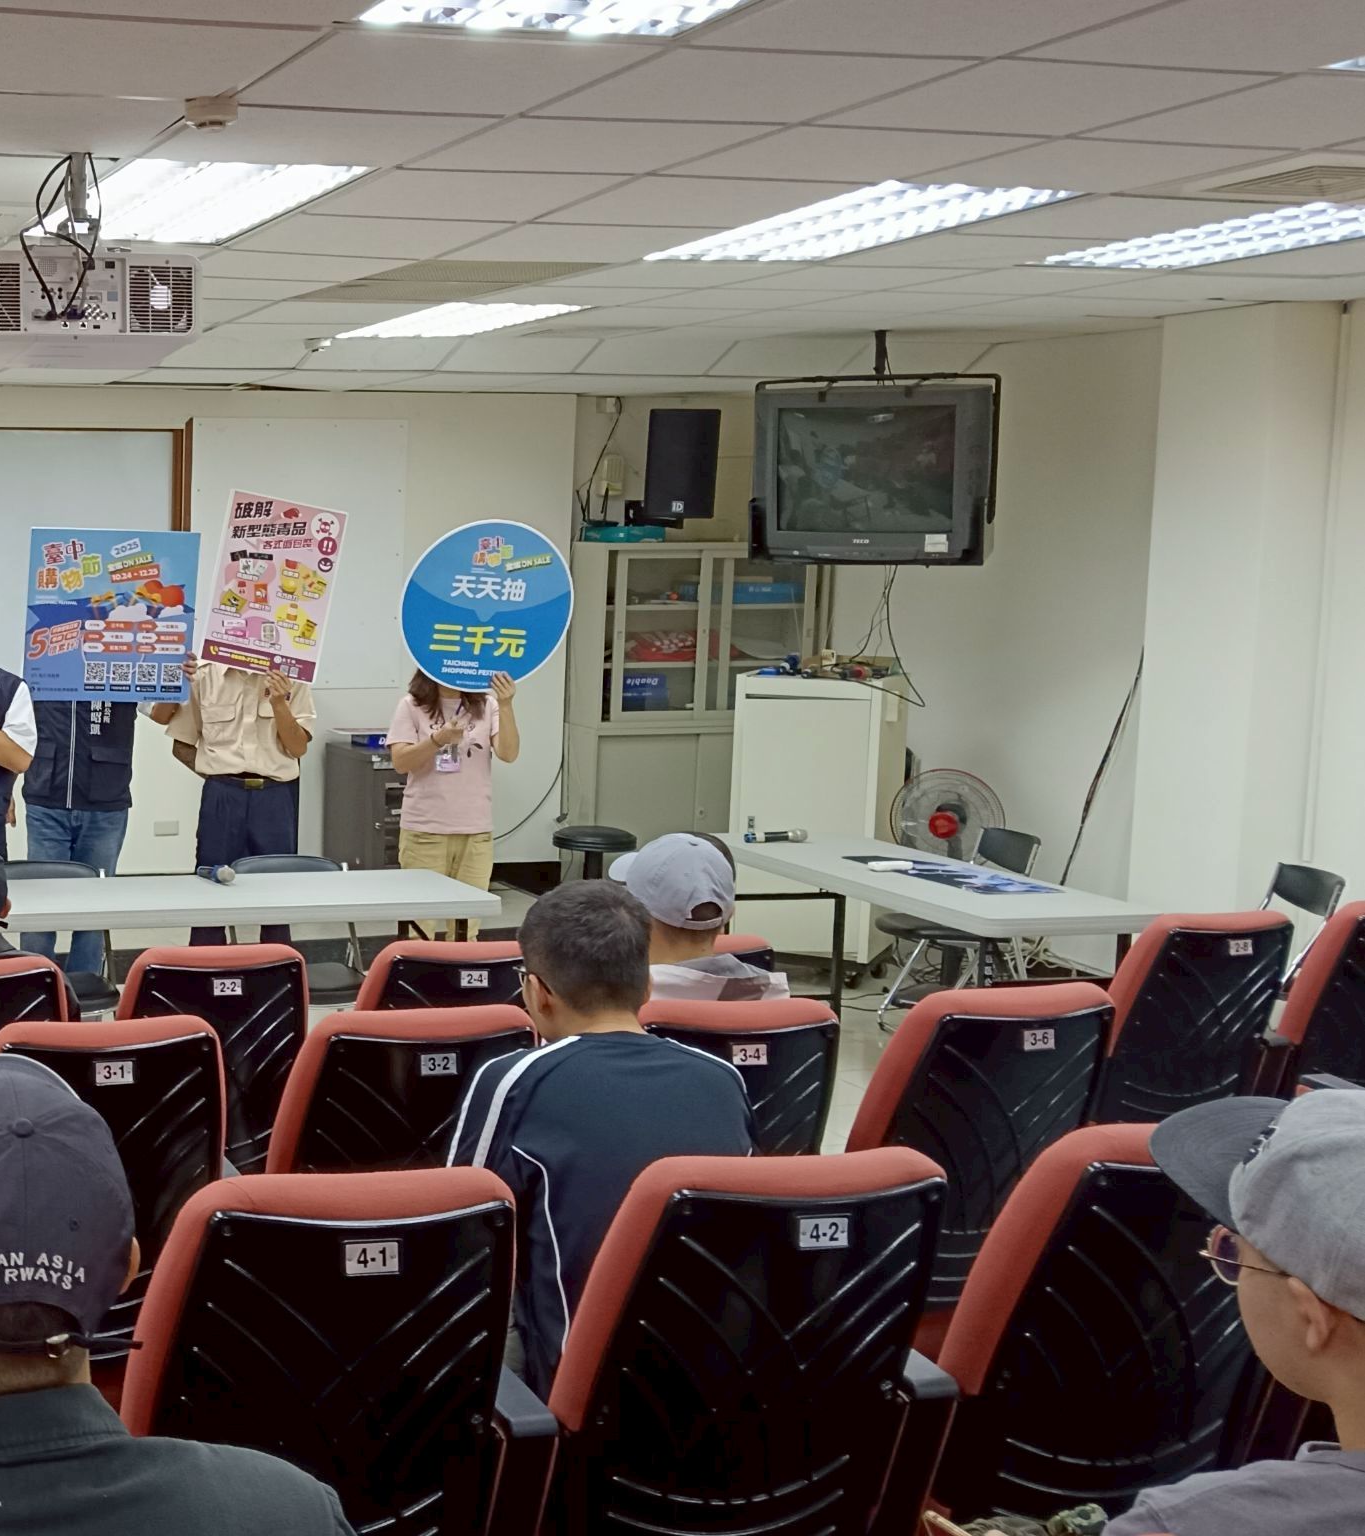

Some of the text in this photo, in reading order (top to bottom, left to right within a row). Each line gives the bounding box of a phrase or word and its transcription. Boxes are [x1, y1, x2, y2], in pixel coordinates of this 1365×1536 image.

[234, 501, 274, 519] 破解
[232, 521, 307, 539] 新型態毒品
[44, 540, 84, 564] 臺中
[114, 541, 139, 555] 2025
[123, 560, 134, 569] ON
[135, 554, 152, 564] SALE
[533, 556, 551, 565] SALE
[450, 574, 526, 602] 天天抽
[29, 628, 50, 658] 5
[429, 623, 527, 658] 三千元
[441, 667, 477, 675] SHOPPING
[220, 981, 237, 993] 2-2
[467, 973, 483, 985] 2-4
[1030, 1032, 1049, 1046] 3-6
[740, 1048, 761, 1062] 3-4
[428, 1056, 450, 1071] 3-2
[103, 1064, 125, 1080] 3-1
[810, 1222, 839, 1242] 4-2
[357, 1246, 387, 1268] 4-1
[36, 1252, 86, 1284] ASIA
